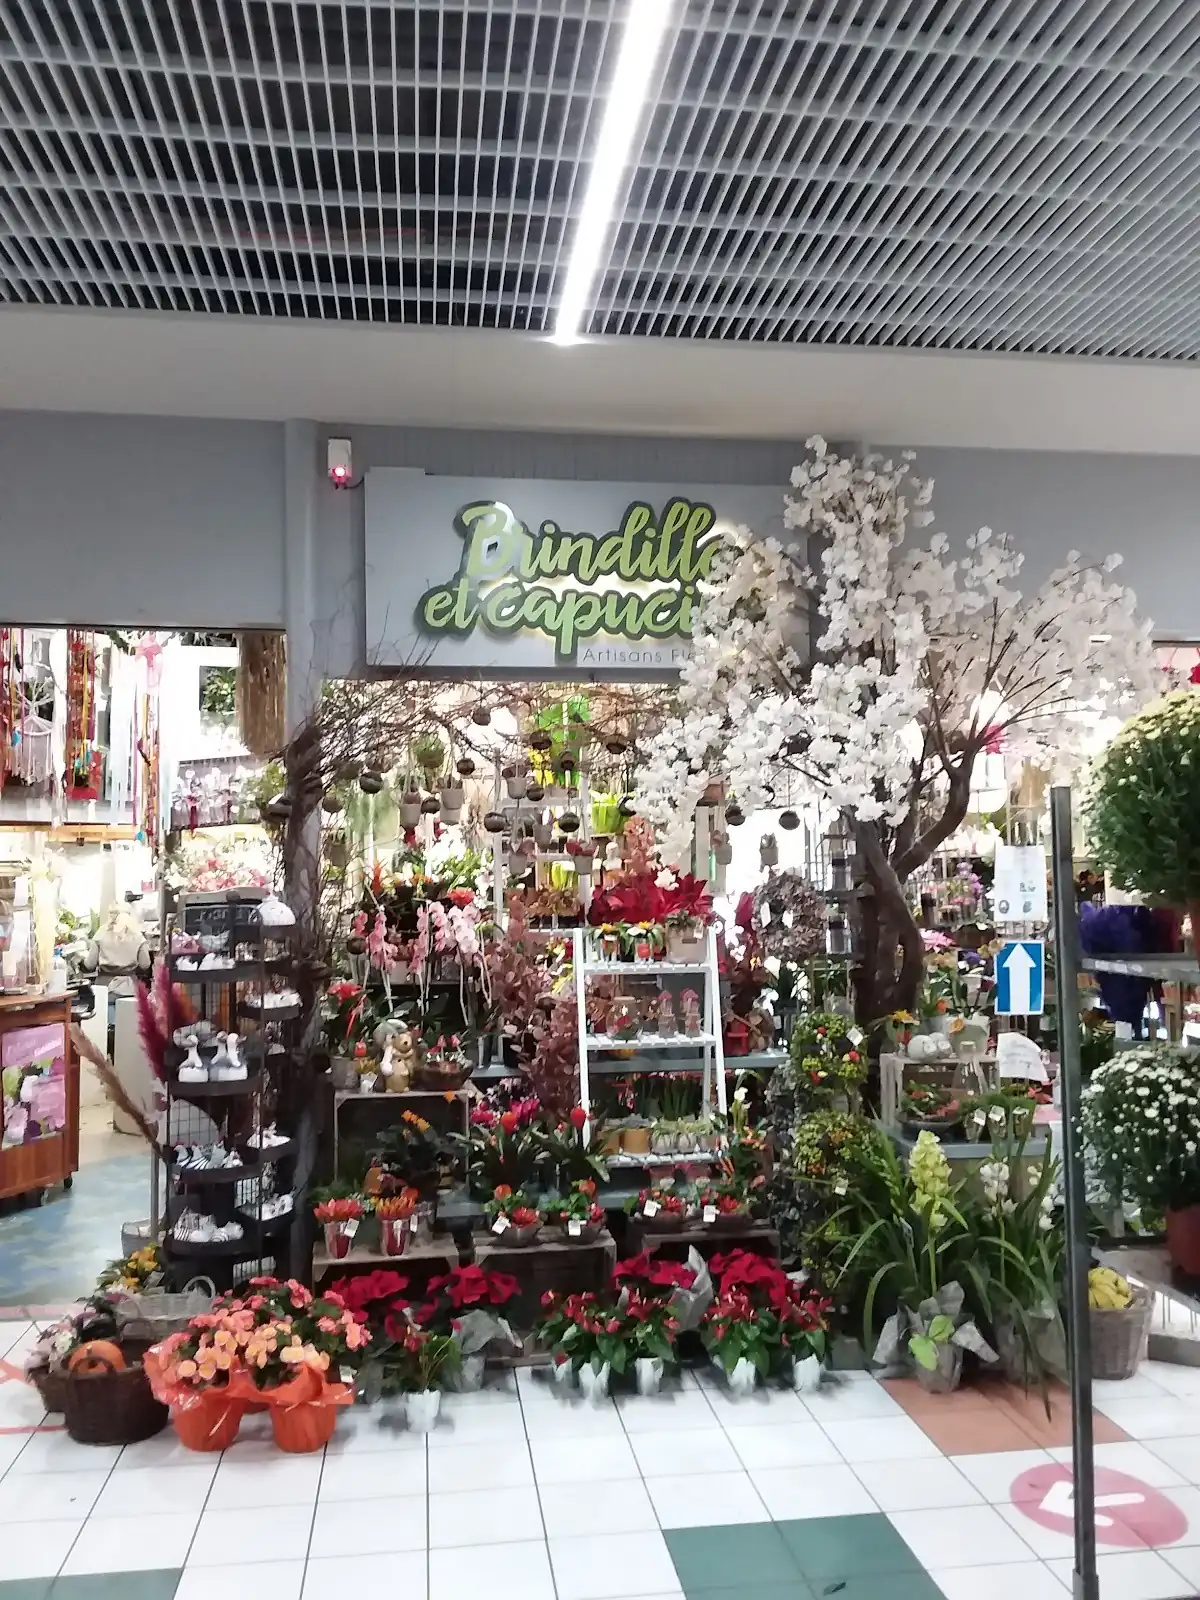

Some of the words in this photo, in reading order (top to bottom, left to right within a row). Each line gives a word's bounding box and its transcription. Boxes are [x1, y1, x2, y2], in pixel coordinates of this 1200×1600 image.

[423, 577, 479, 630] et
[486, 585, 703, 655] capuci
[582, 648, 662, 662] Artisans
